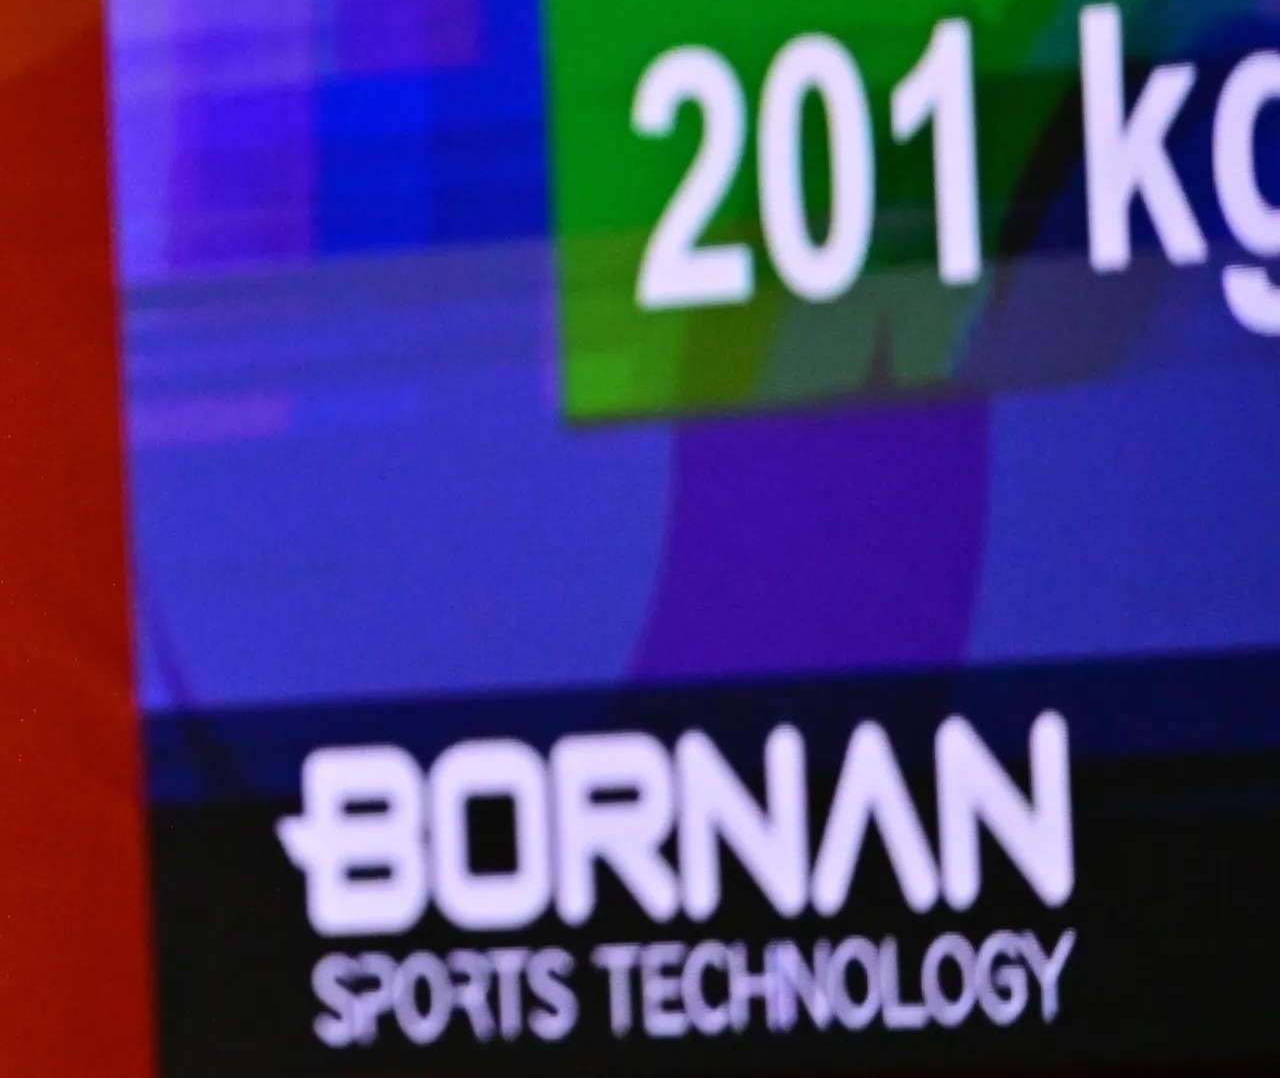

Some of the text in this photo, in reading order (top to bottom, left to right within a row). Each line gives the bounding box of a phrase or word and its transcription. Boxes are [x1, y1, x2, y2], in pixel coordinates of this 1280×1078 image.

[631, 17, 983, 311] 201
[276, 708, 1075, 937] BORNAN
[311, 928, 1077, 1047] SPORTS TECHNOLOGY
